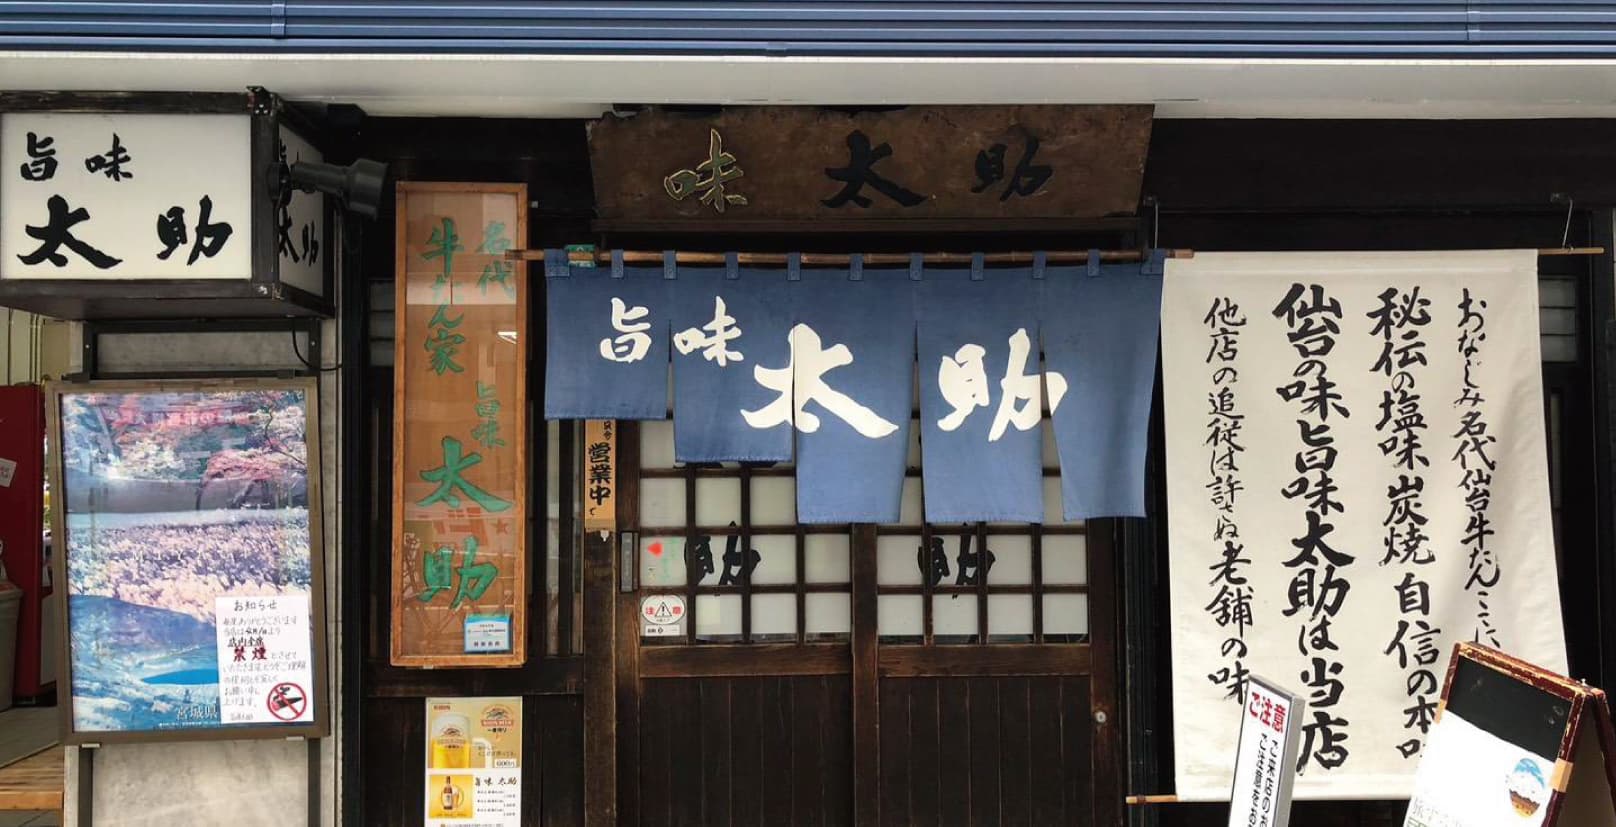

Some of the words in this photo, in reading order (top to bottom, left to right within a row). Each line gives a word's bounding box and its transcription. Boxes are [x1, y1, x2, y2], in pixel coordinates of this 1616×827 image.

[20, 131, 133, 182] 旨味
[16, 194, 233, 270] 太助
[475, 221, 515, 300] 名代
[420, 217, 467, 377] 牛たん家
[599, 296, 745, 368] 旨味
[470, 380, 507, 449] 旨味
[740, 322, 1069, 443] 太助
[588, 441, 612, 505] 営業中
[414, 435, 515, 612] 太助
[1271, 282, 1356, 777] 仙台の味旨味太助は当店
[234, 599, 278, 612] お知らせ
[233, 647, 268, 662] 禁煙
[1248, 691, 1288, 735] ご注意
